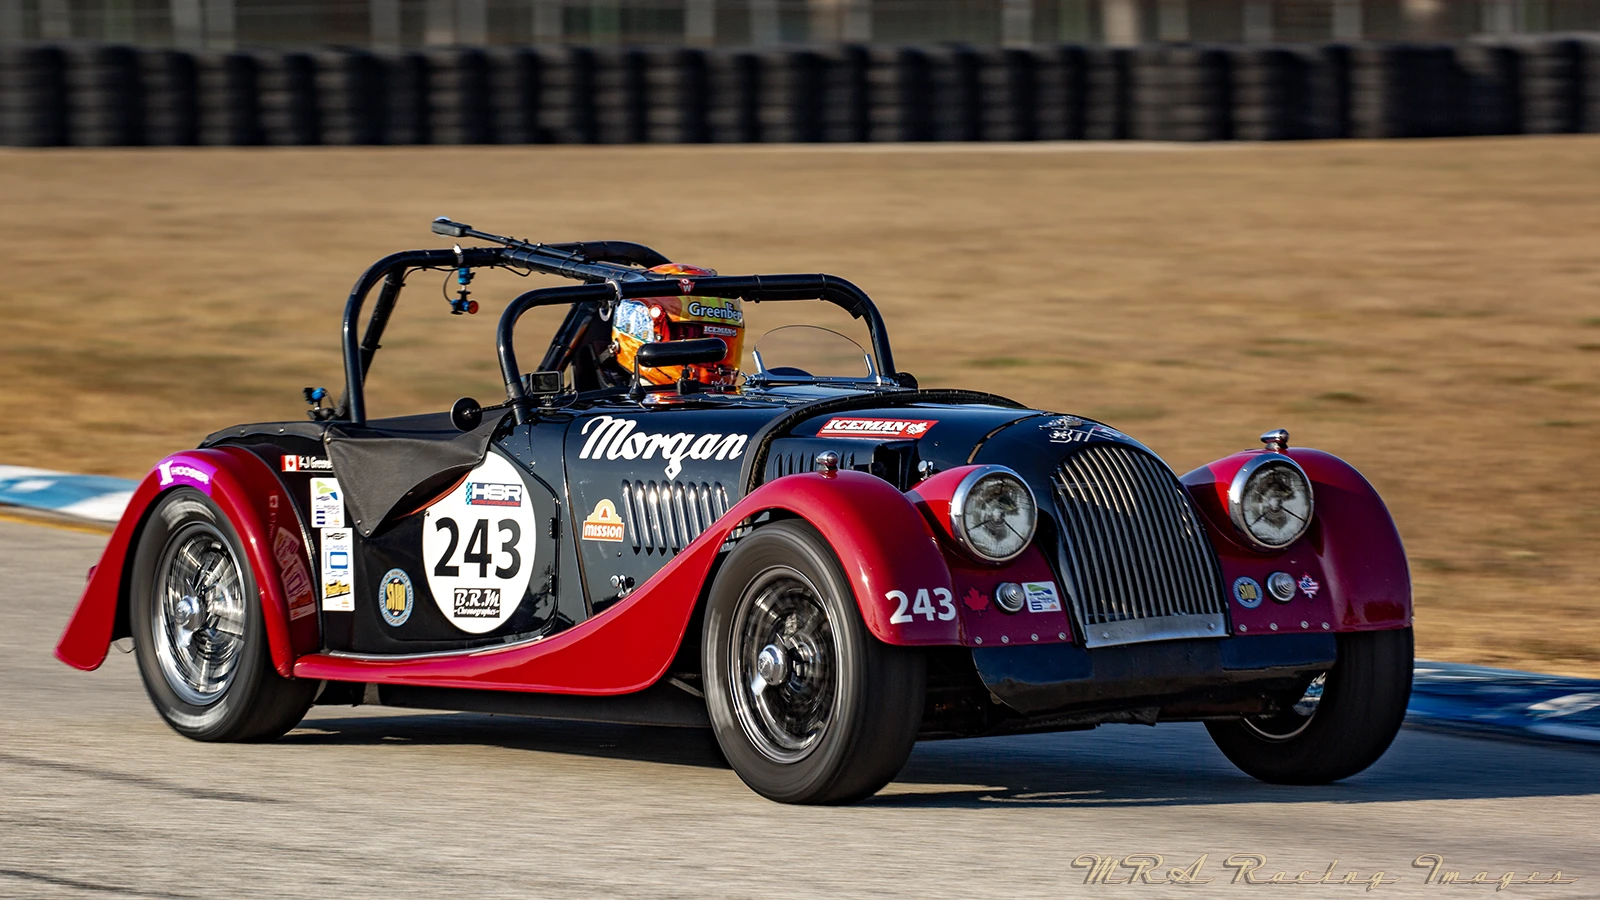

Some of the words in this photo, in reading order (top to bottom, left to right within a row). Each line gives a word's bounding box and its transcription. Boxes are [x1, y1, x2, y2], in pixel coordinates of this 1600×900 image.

[823, 419, 910, 431] ICEMAN
[579, 415, 748, 481] Morgan
[472, 484, 521, 502] HSR
[584, 524, 623, 538] MISSION
[434, 517, 521, 580] 243
[884, 587, 957, 625] 243
